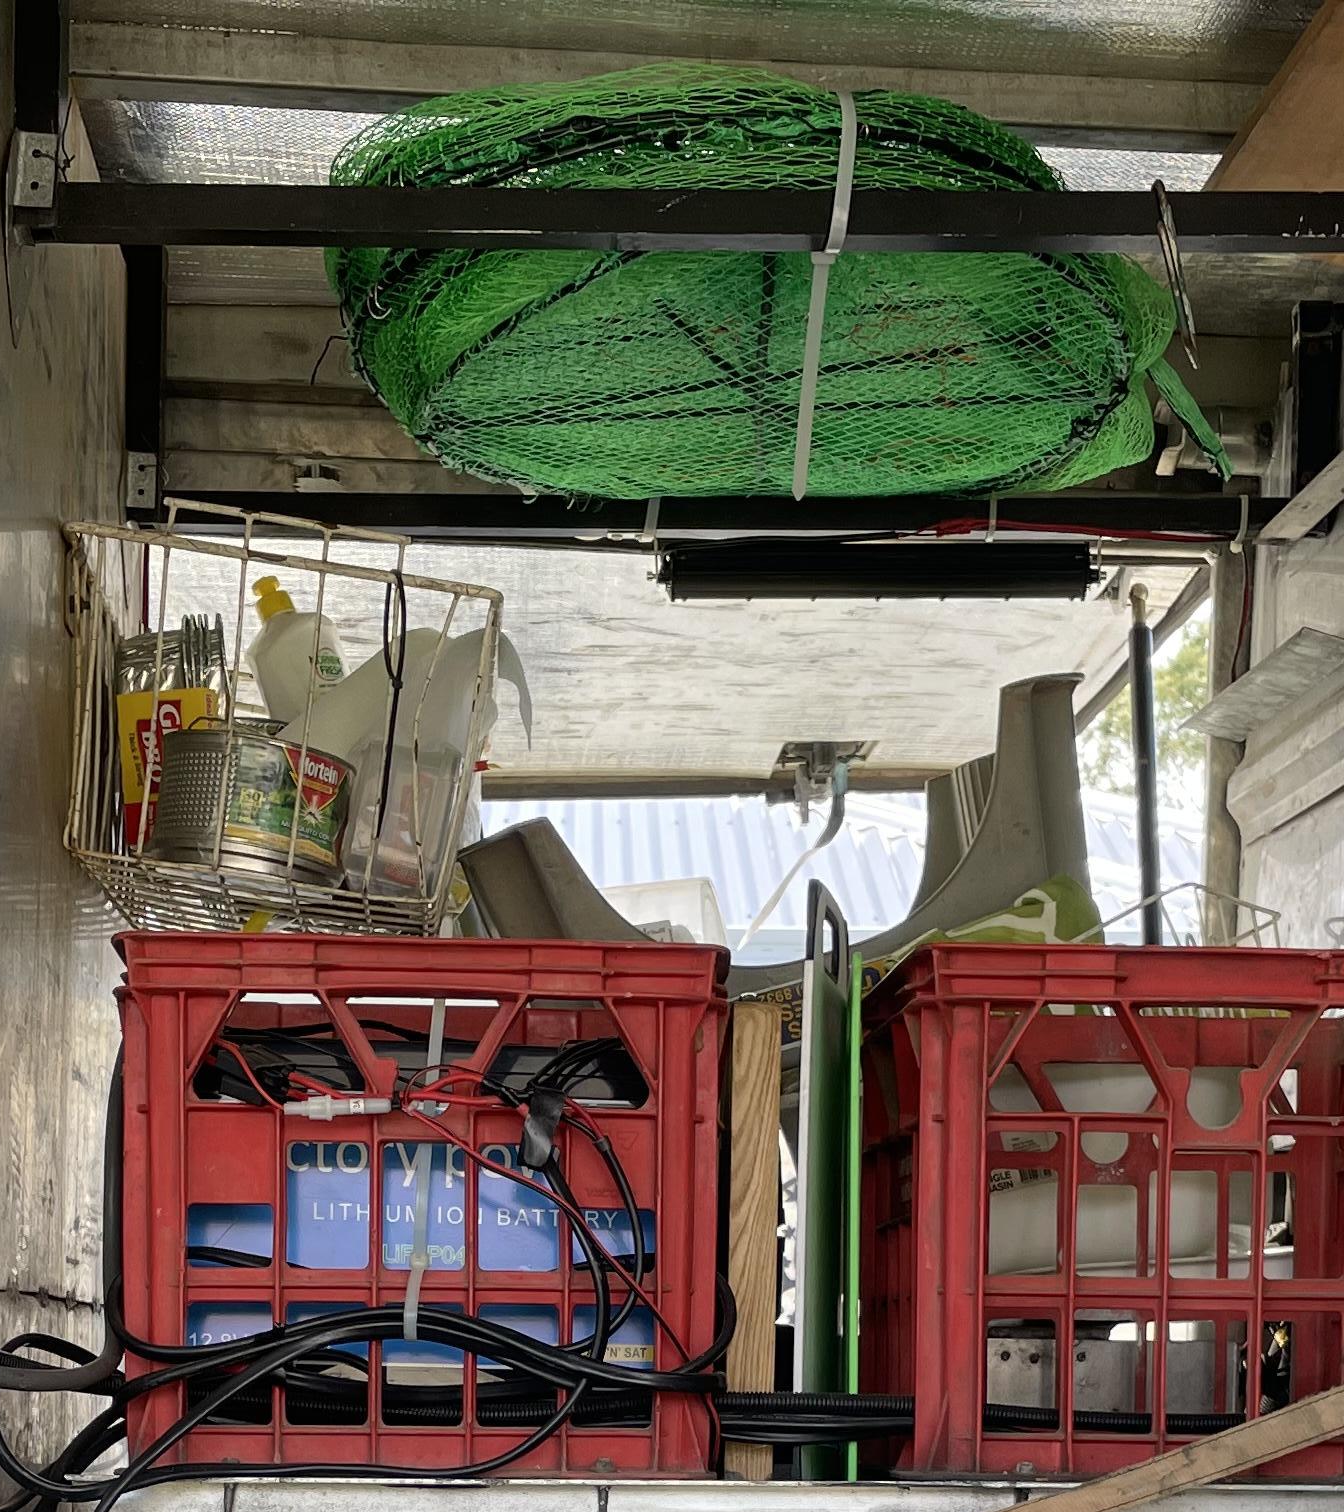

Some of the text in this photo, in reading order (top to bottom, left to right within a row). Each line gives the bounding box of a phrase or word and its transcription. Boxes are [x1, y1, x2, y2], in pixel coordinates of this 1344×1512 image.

[990, 1181, 1014, 1193] ASIN
[497, 1208, 618, 1229] BATTRY
[624, 1347, 647, 1359] SAT
